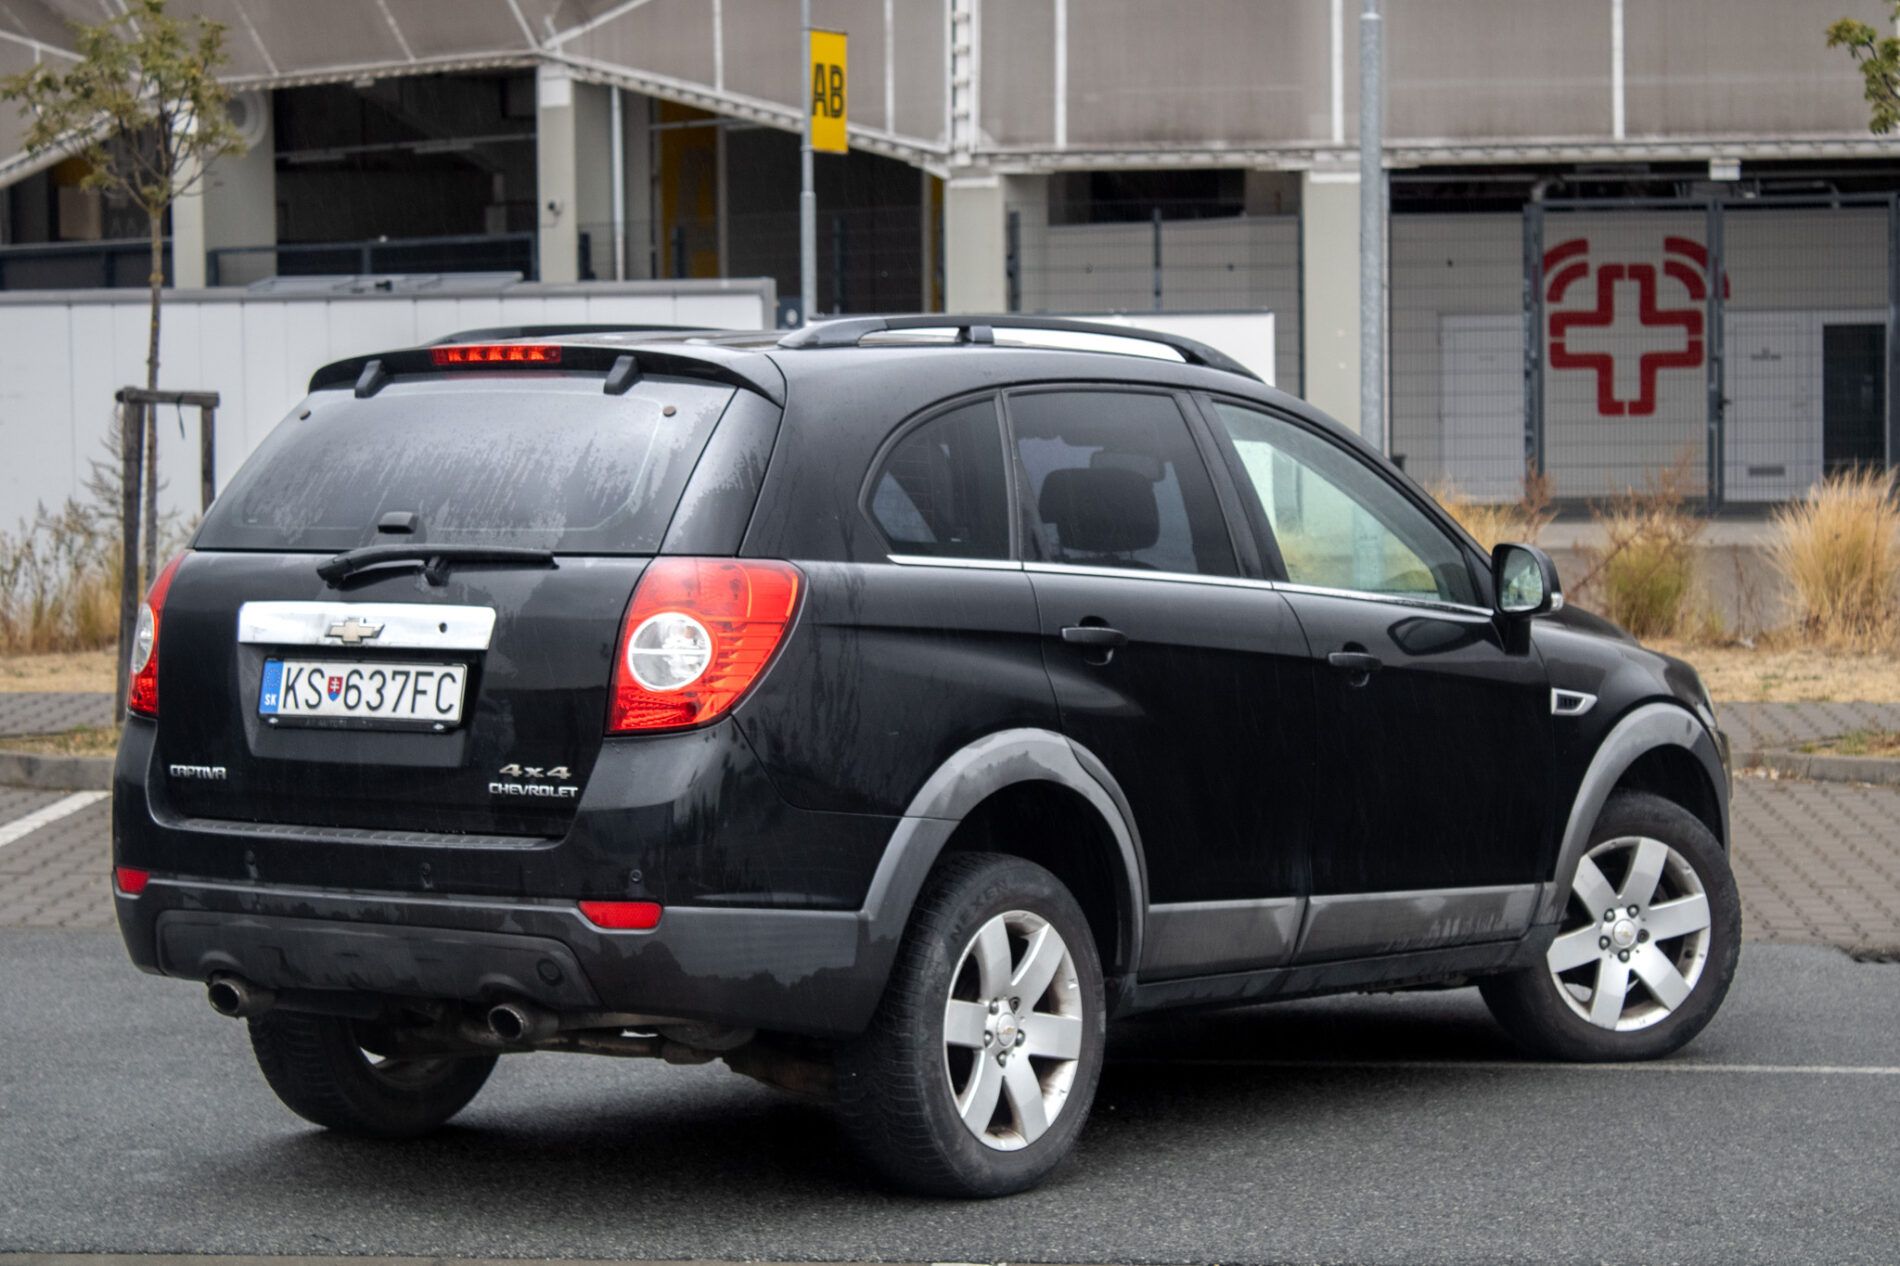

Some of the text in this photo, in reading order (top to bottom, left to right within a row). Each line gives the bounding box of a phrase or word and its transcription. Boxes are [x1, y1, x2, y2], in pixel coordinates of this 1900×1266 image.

[812, 63, 844, 118] AB
[282, 667, 457, 714] KS 637FC
[264, 693, 278, 706] SK
[169, 764, 227, 780] CAPTIVA
[499, 763, 572, 779] 4x4
[488, 782, 579, 798] CHEVROLET
